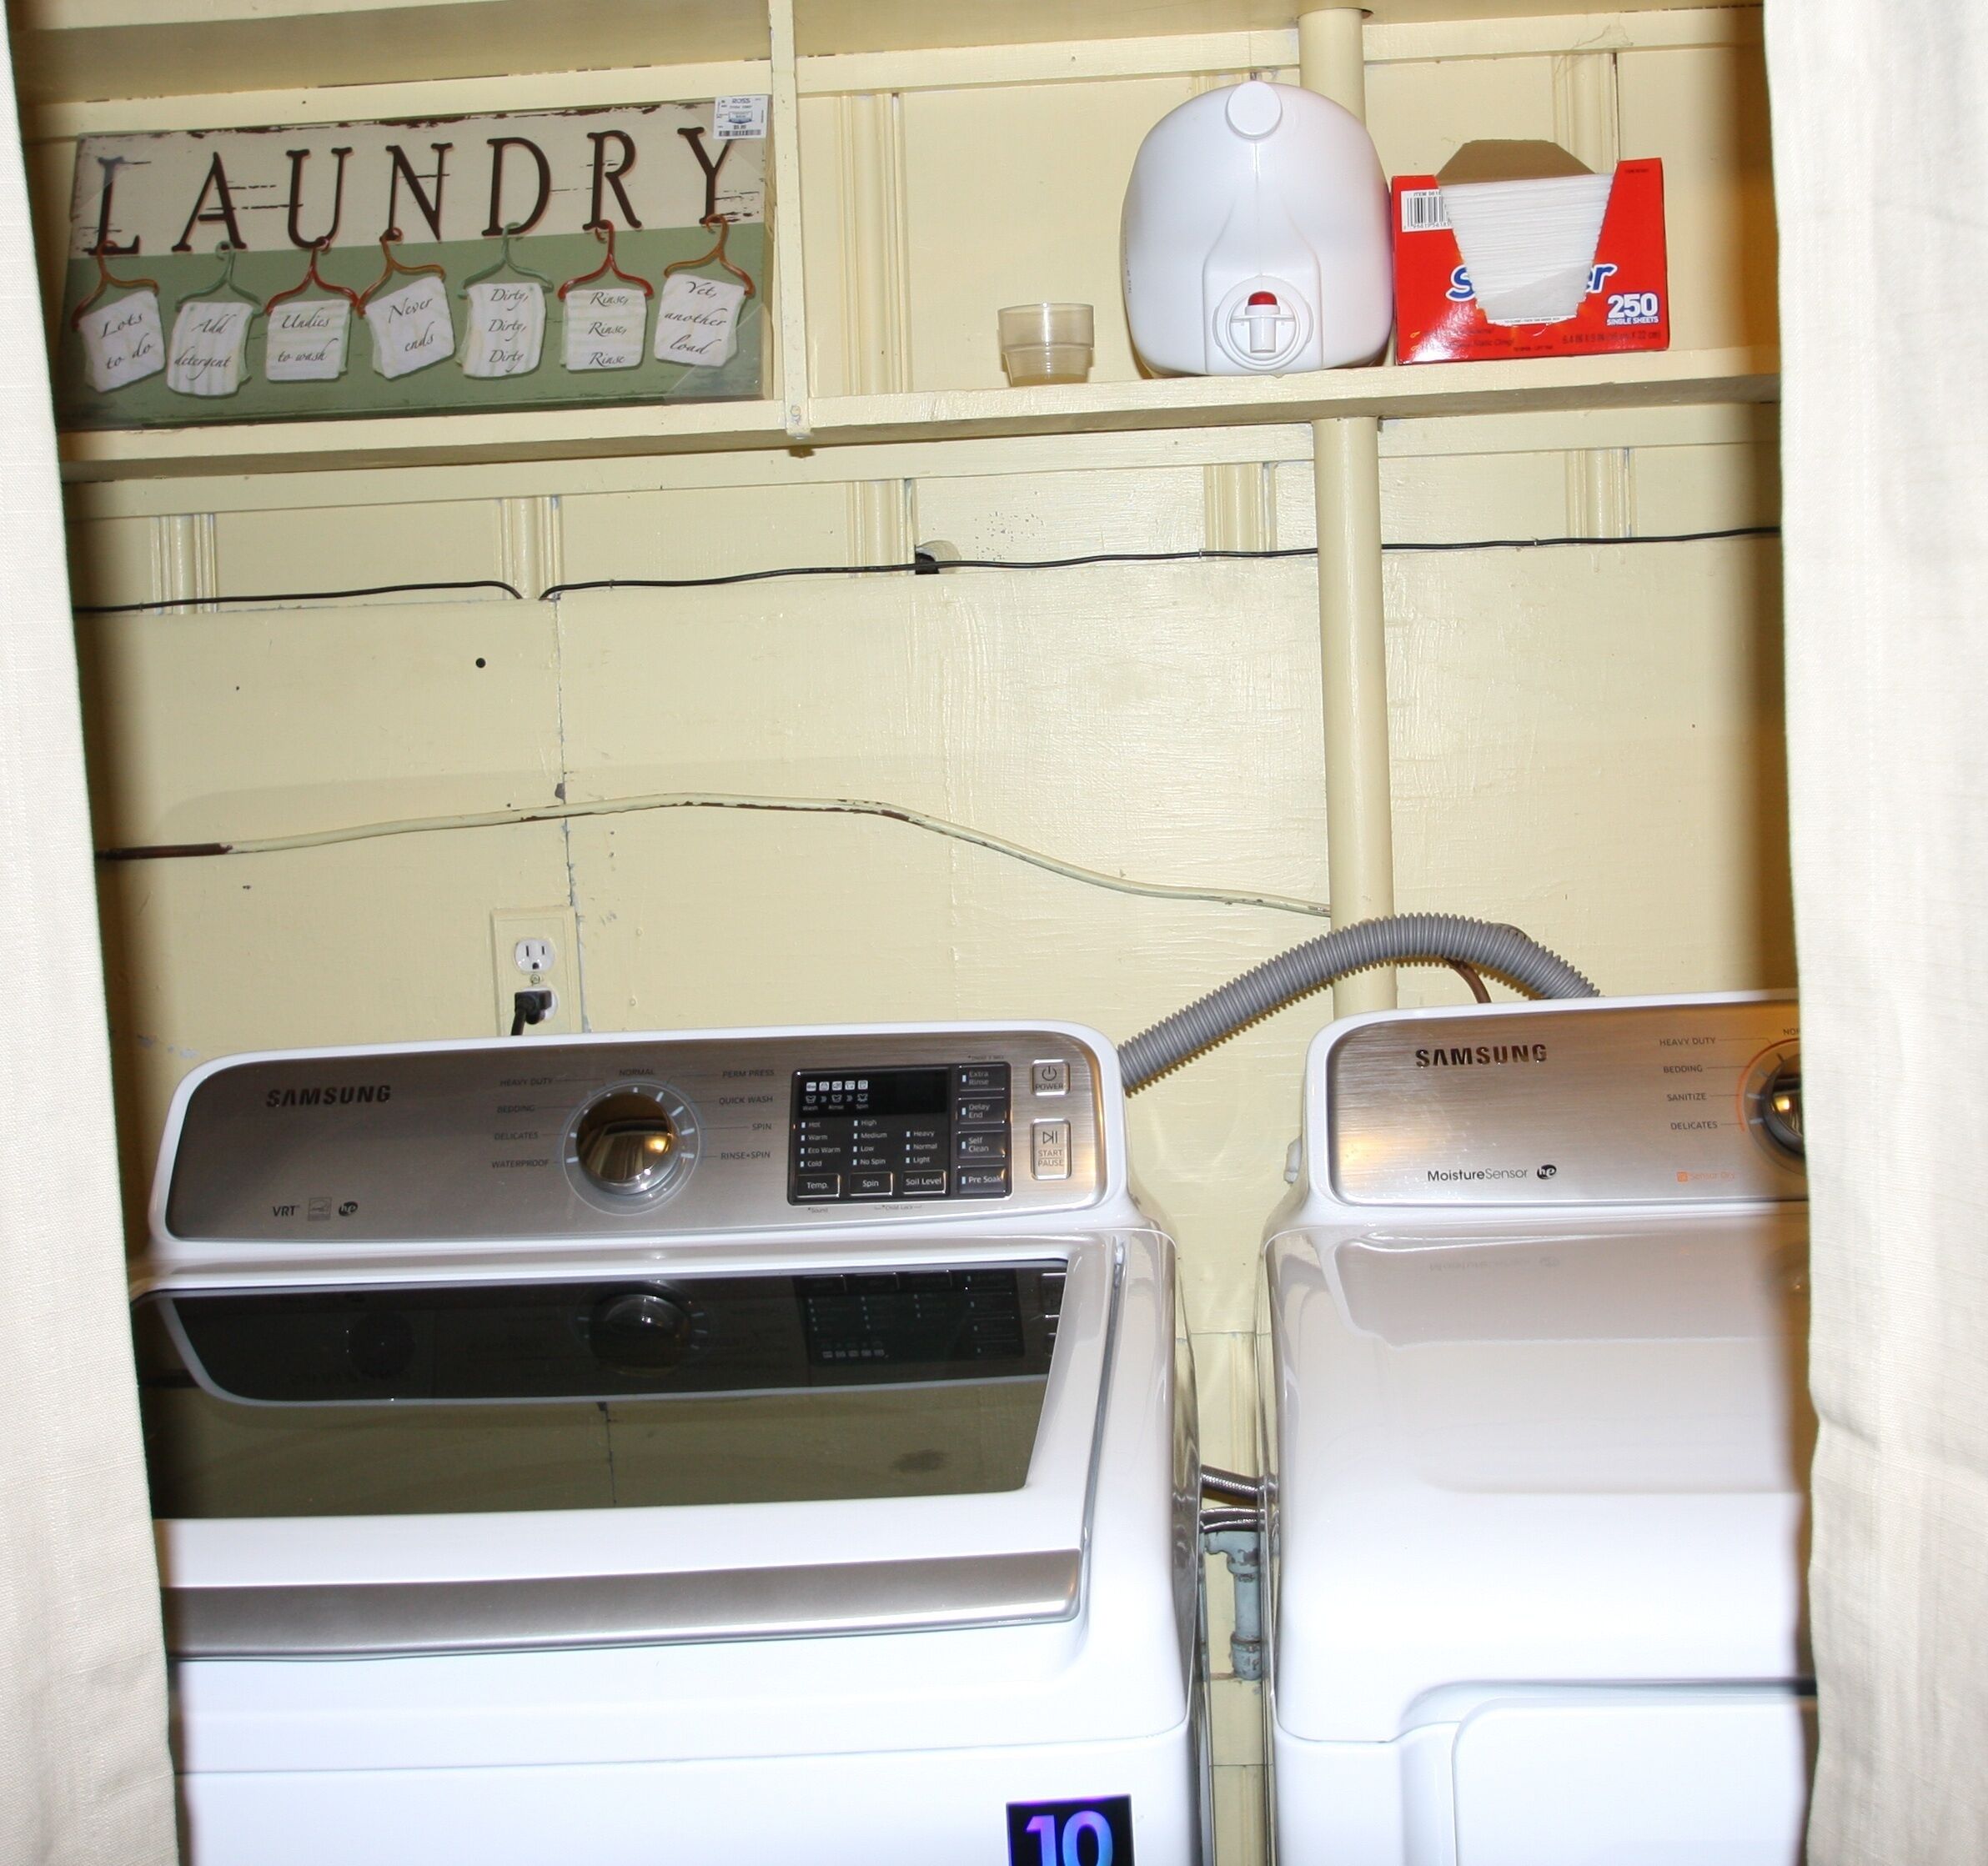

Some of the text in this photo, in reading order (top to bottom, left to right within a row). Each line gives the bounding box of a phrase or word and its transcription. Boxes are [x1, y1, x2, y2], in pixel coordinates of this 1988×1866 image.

[85, 127, 739, 255] LAUNDRY
[686, 280, 716, 298] Yet,
[490, 288, 530, 311] Dirty,
[590, 291, 629, 306] Rinse,
[1608, 293, 1658, 319] 250
[282, 308, 330, 329] Undies
[389, 298, 433, 324] Never
[664, 308, 728, 327] another
[101, 313, 143, 339] Lots
[192, 314, 238, 334] Add
[588, 322, 627, 336] Rinse,
[1606, 316, 1659, 326] SINGLE SHEETS
[404, 322, 434, 353] ends
[488, 319, 527, 341] Dirty,
[107, 334, 153, 369] to do
[278, 338, 339, 363] to wash
[670, 334, 719, 355] load
[174, 346, 232, 381] detergent
[489, 349, 525, 373] Dirty
[588, 352, 625, 366] Rinse
[1659, 1038, 1690, 1046] HEAVY
[1415, 1044, 1547, 1067] SAMSUNG
[619, 1068, 654, 1076] NORMAL
[722, 1069, 775, 1078] PERM PRESS
[1663, 1065, 1703, 1074] BEDDING
[500, 1077, 553, 1086] HEAVY DUTY
[266, 1085, 392, 1108] SAMSUNG
[719, 1096, 746, 1105] QUICK
[1666, 1093, 1707, 1101] SANITIZE
[497, 1105, 535, 1114] BEDDING
[1670, 1121, 1718, 1131] DELICATES
[494, 1131, 539, 1141] DELICATES
[491, 1159, 550, 1169] WATERPROOF
[807, 1181, 828, 1191] Temp.
[862, 1179, 879, 1188] Spin
[921, 1177, 942, 1186] Level
[273, 1206, 296, 1216] VRT
[1026, 1810, 1114, 1866] 10
